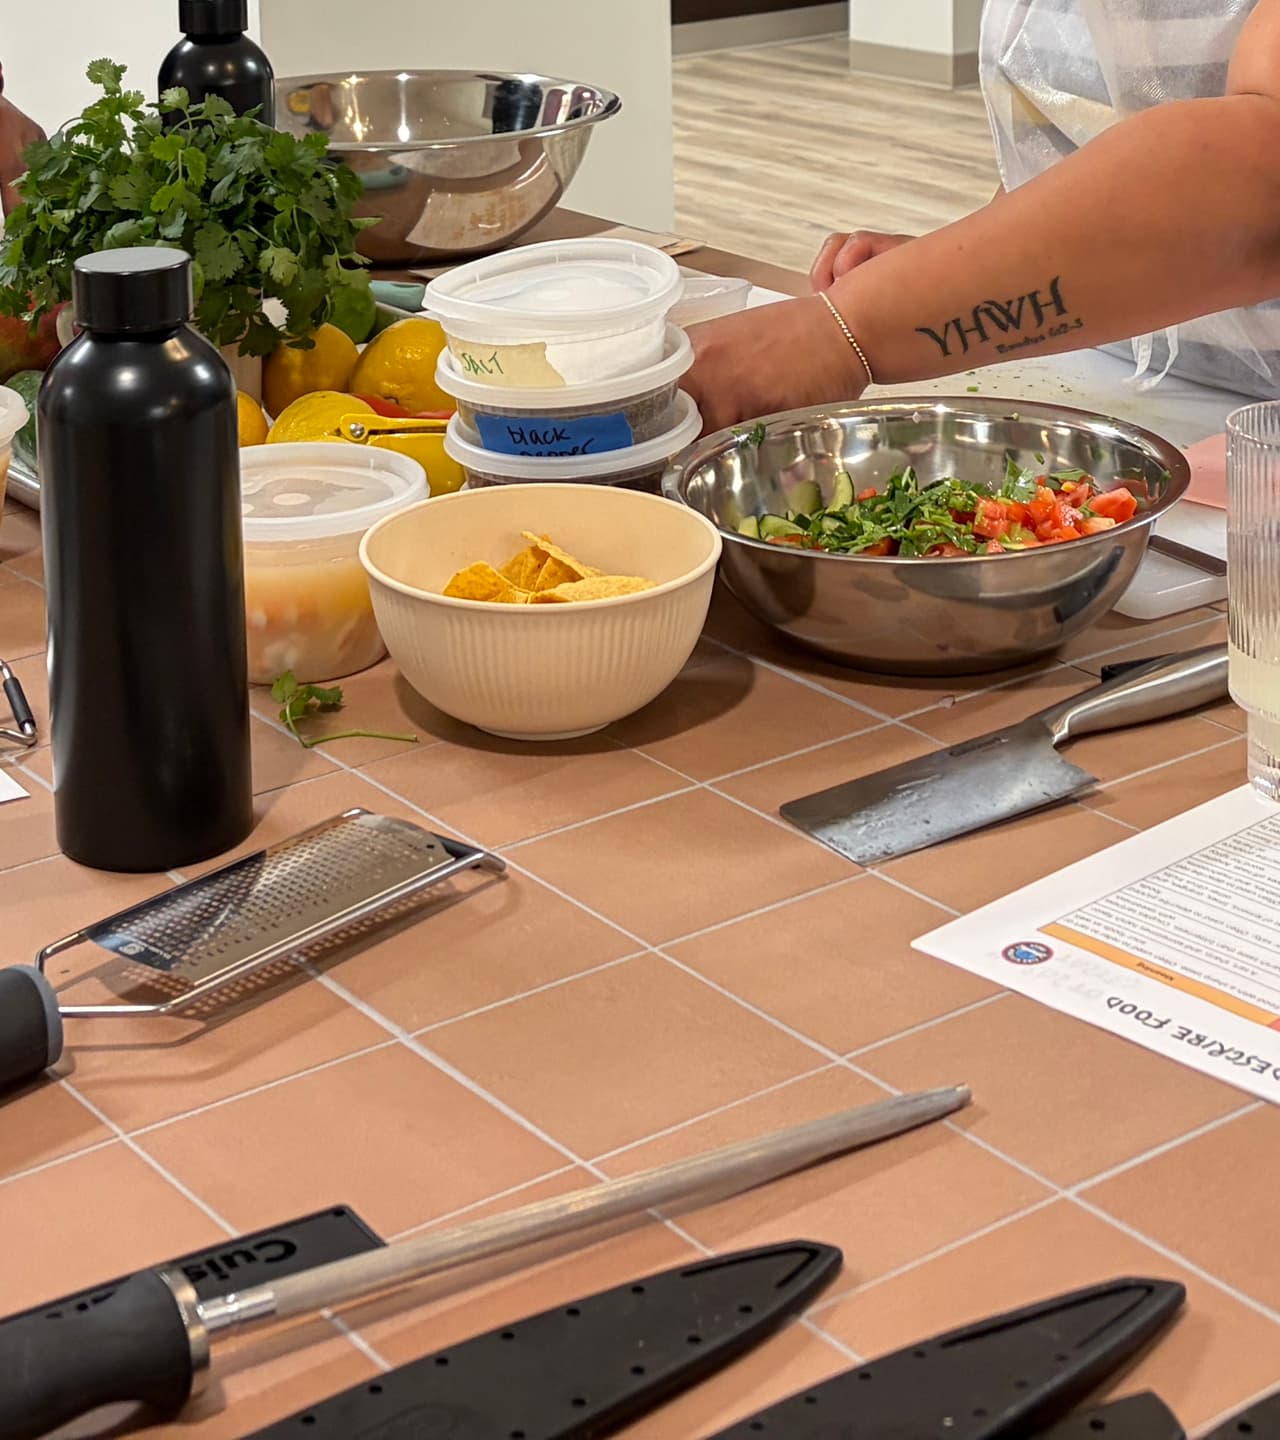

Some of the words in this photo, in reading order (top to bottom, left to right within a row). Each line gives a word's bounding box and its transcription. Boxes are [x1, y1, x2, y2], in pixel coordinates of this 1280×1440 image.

[914, 275, 1068, 357] YHWH
[461, 351, 505, 376] SALT
[506, 424, 571, 445] black
[1107, 995, 1171, 1030] FOOD
